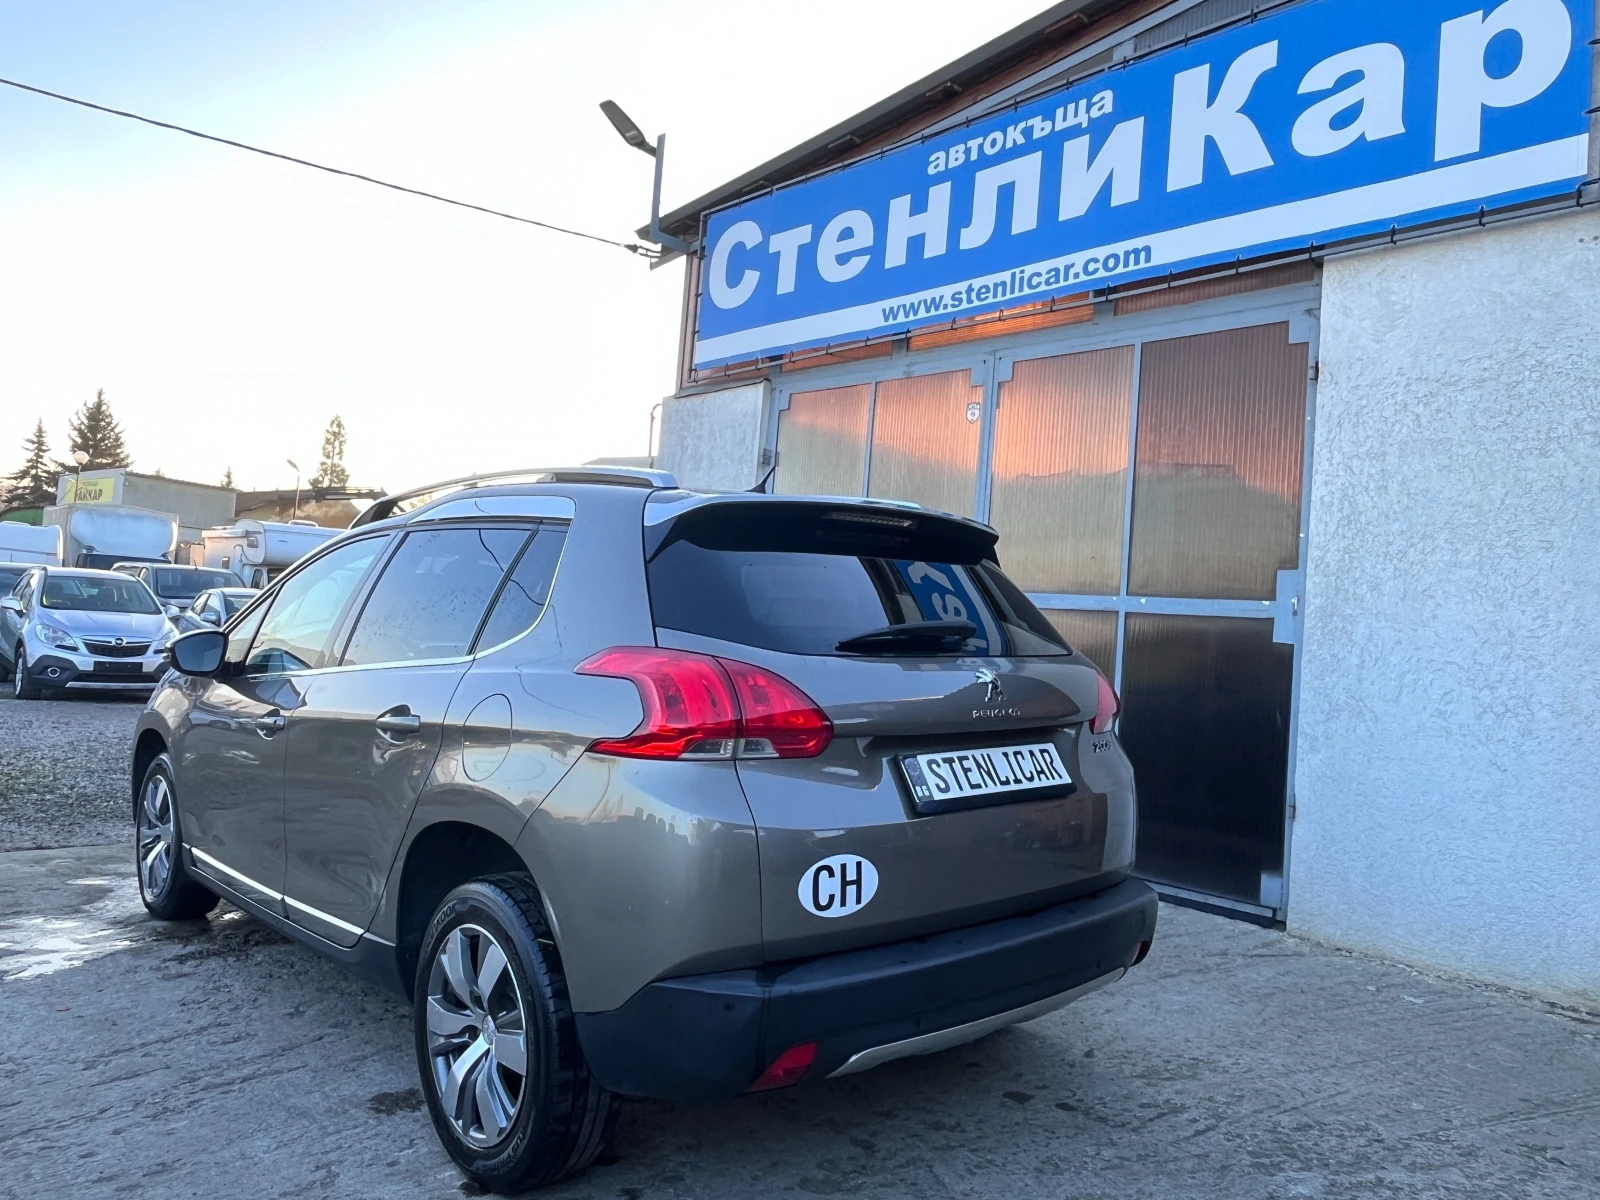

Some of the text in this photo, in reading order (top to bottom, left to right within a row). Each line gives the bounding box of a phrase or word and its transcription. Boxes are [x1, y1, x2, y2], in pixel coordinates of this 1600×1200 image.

[708, 0, 1573, 310] СтенлиКар
[927, 89, 1114, 175] автокъща
[882, 244, 1152, 323] www.stenlicar.com
[926, 748, 1063, 794] STENLICAR
[812, 860, 863, 912] CH
